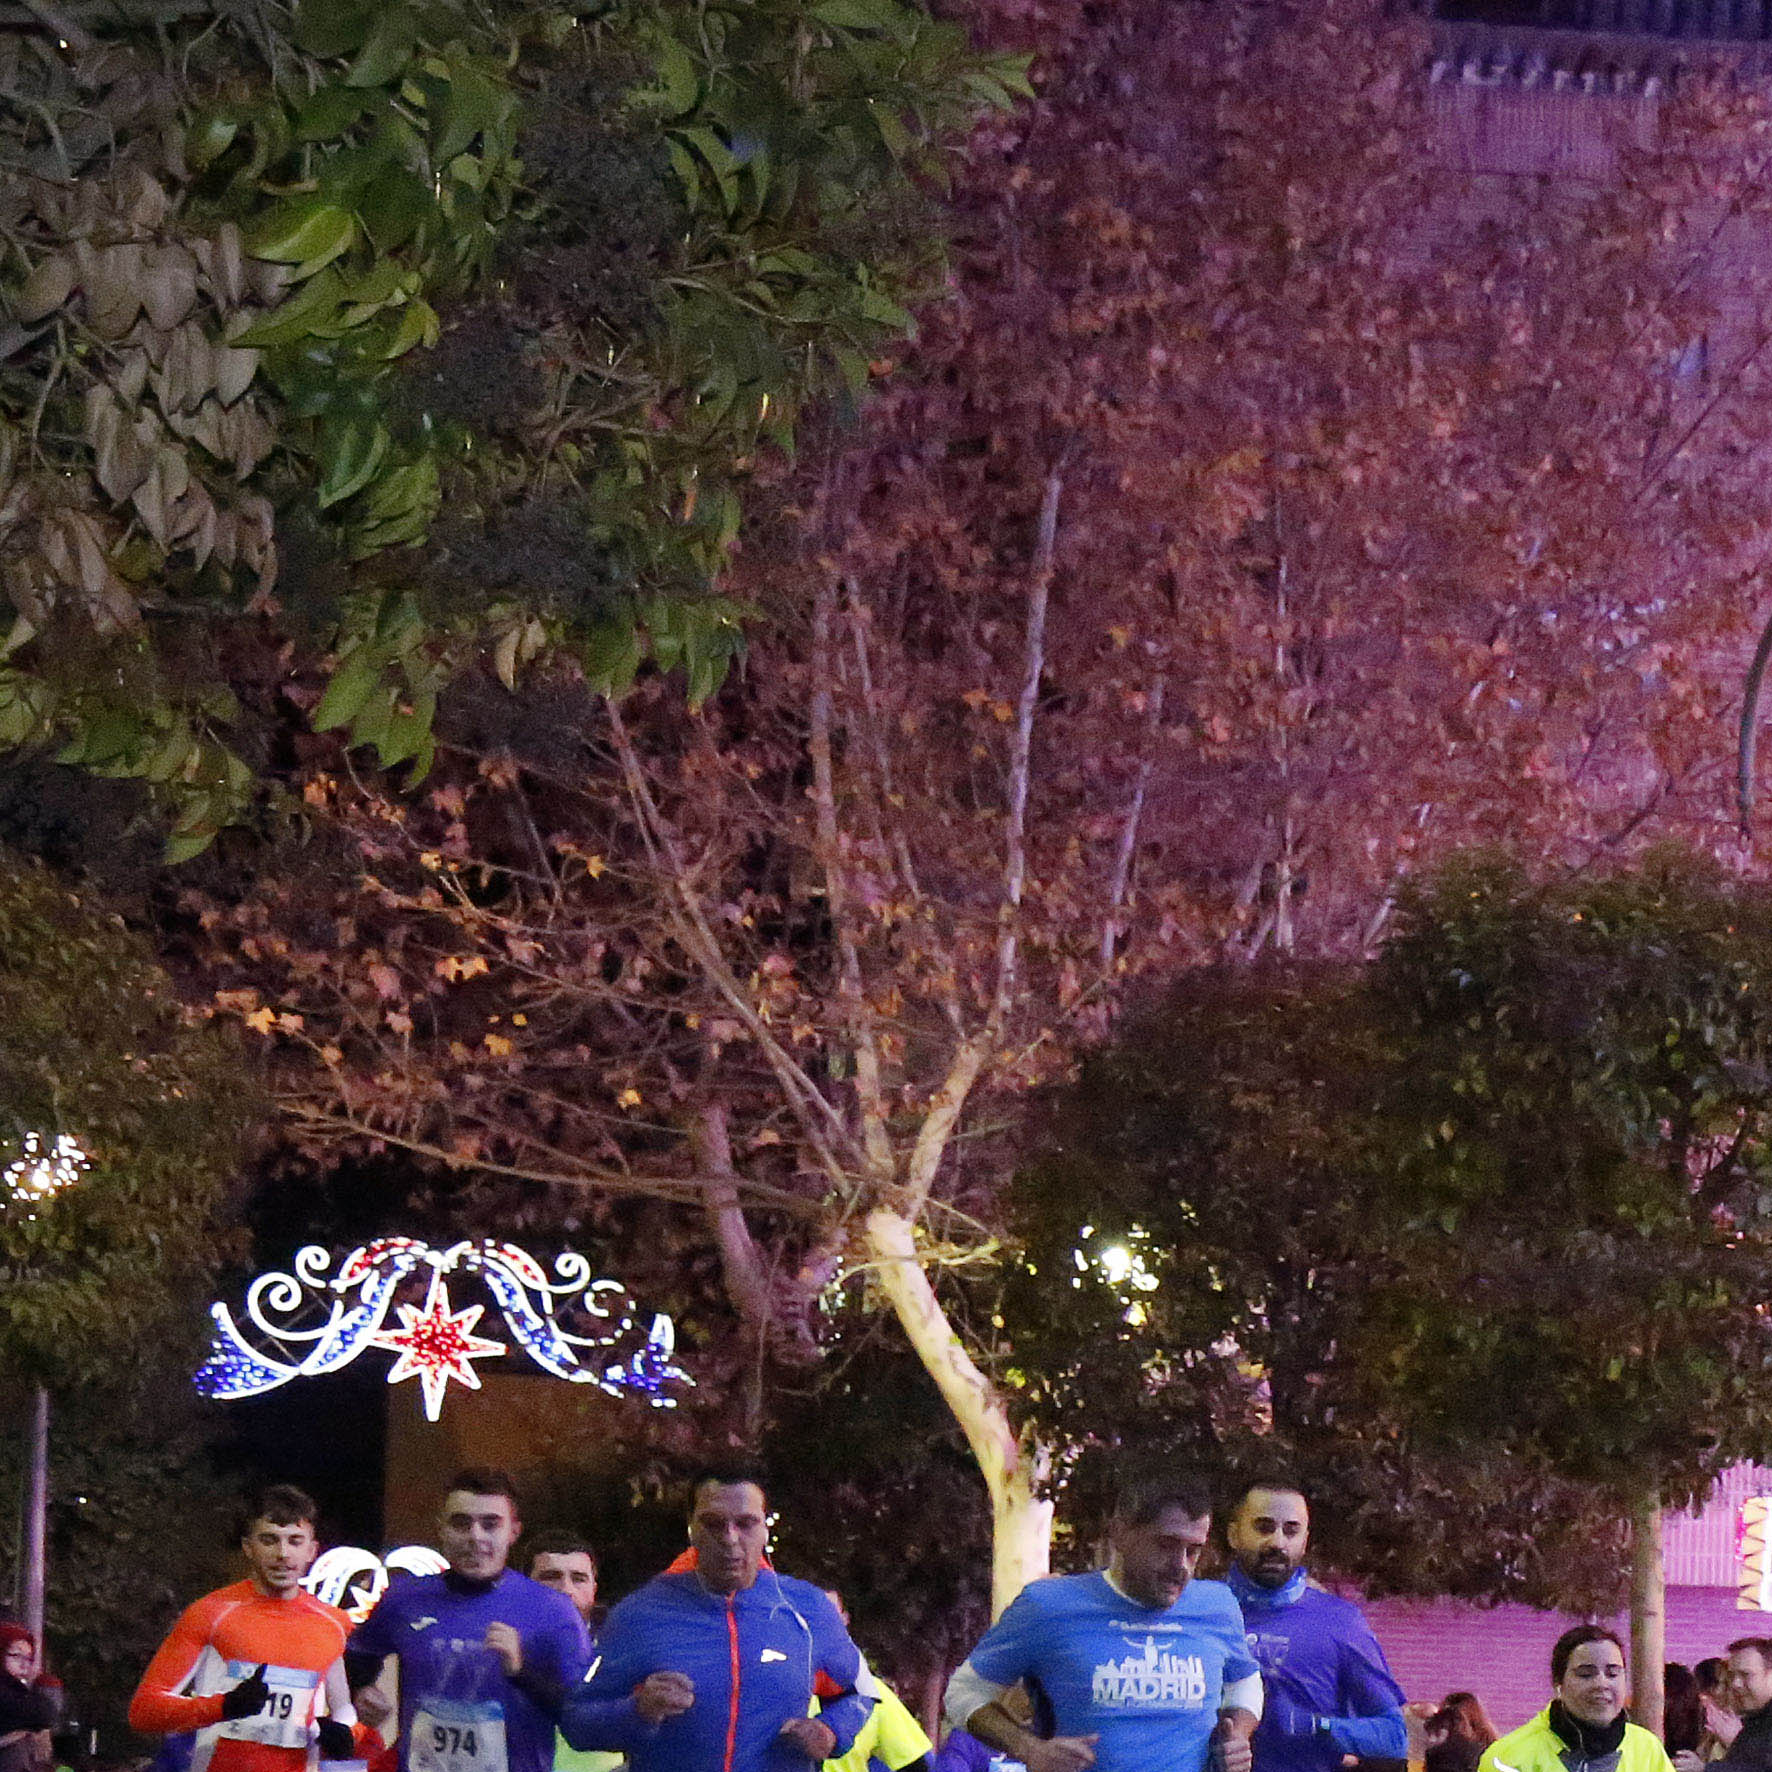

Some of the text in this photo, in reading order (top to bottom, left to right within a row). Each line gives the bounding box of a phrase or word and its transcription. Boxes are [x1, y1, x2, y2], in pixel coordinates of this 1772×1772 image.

[1092, 1677, 1206, 1702] MADRID
[268, 1693, 294, 1720] 19
[433, 1726, 477, 1758] 974
